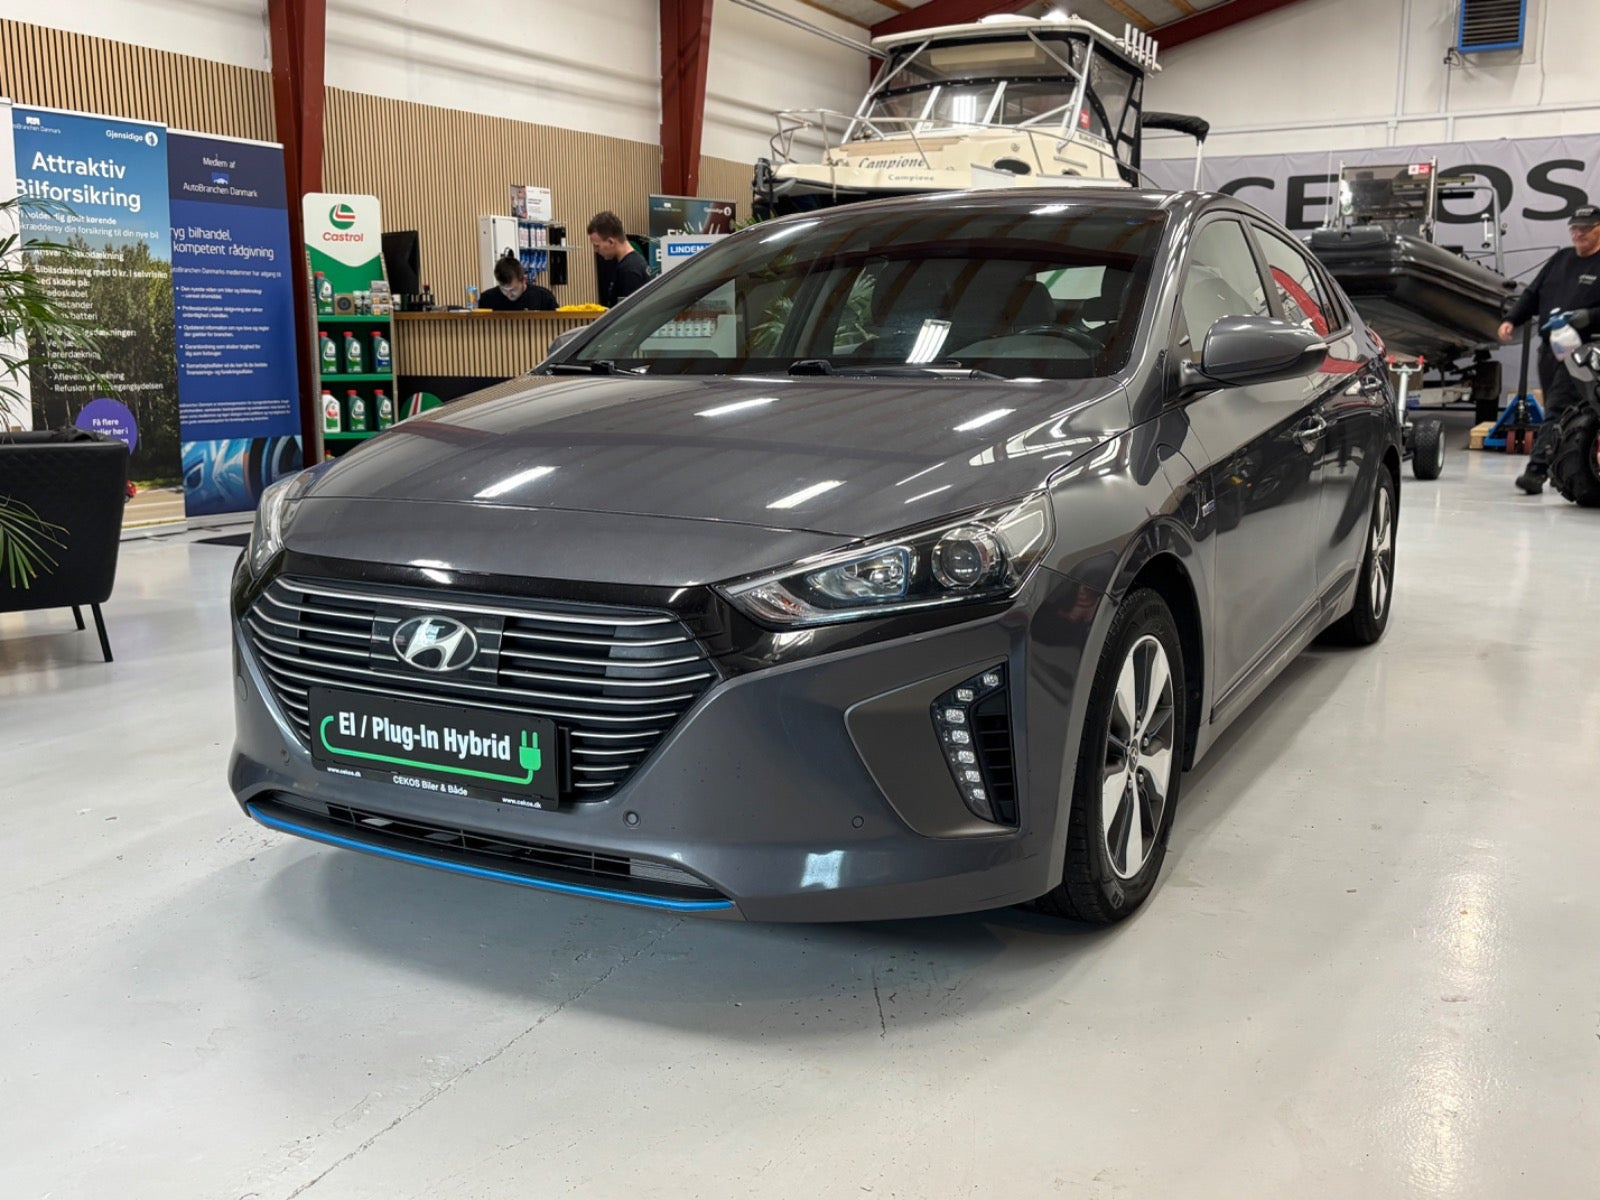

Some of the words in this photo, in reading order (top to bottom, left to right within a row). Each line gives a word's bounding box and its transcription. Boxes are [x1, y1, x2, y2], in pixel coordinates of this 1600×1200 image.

[106, 129, 143, 142] Gjensidige
[32, 151, 126, 179] Attraktiv
[203, 155, 227, 168] Medlem
[229, 160, 236, 168] af
[858, 156, 925, 169] Campione
[183, 182, 229, 194] AutoBranchen
[230, 187, 258, 197] Danmark
[86, 214, 117, 225] kørende
[20, 222, 62, 233] kræddersy
[64, 224, 76, 233] din
[78, 225, 113, 237] forsikring
[123, 228, 134, 238] din
[135, 231, 149, 240] nye
[150, 230, 158, 239] bil
[169, 227, 185, 240] ryg
[188, 226, 232, 241] bilhandel,
[322, 231, 364, 242] Castrol
[173, 240, 226, 256] kompetent
[229, 243, 275, 261] rådgivning
[670, 245, 708, 254] LINDEM
[54, 383, 87, 392] Refusion
[102, 418, 119, 426] flere
[338, 711, 356, 736] El
[361, 715, 367, 738] /
[372, 716, 439, 751] Plug-In
[443, 727, 511, 760] Hybrid
[326, 766, 362, 778] www.cekos.dk
[392, 775, 420, 788] CEKOS
[421, 779, 438, 792] Biler
[440, 784, 446, 793] &
[447, 783, 468, 796] Både
[502, 796, 542, 809] www.cekos.dk
